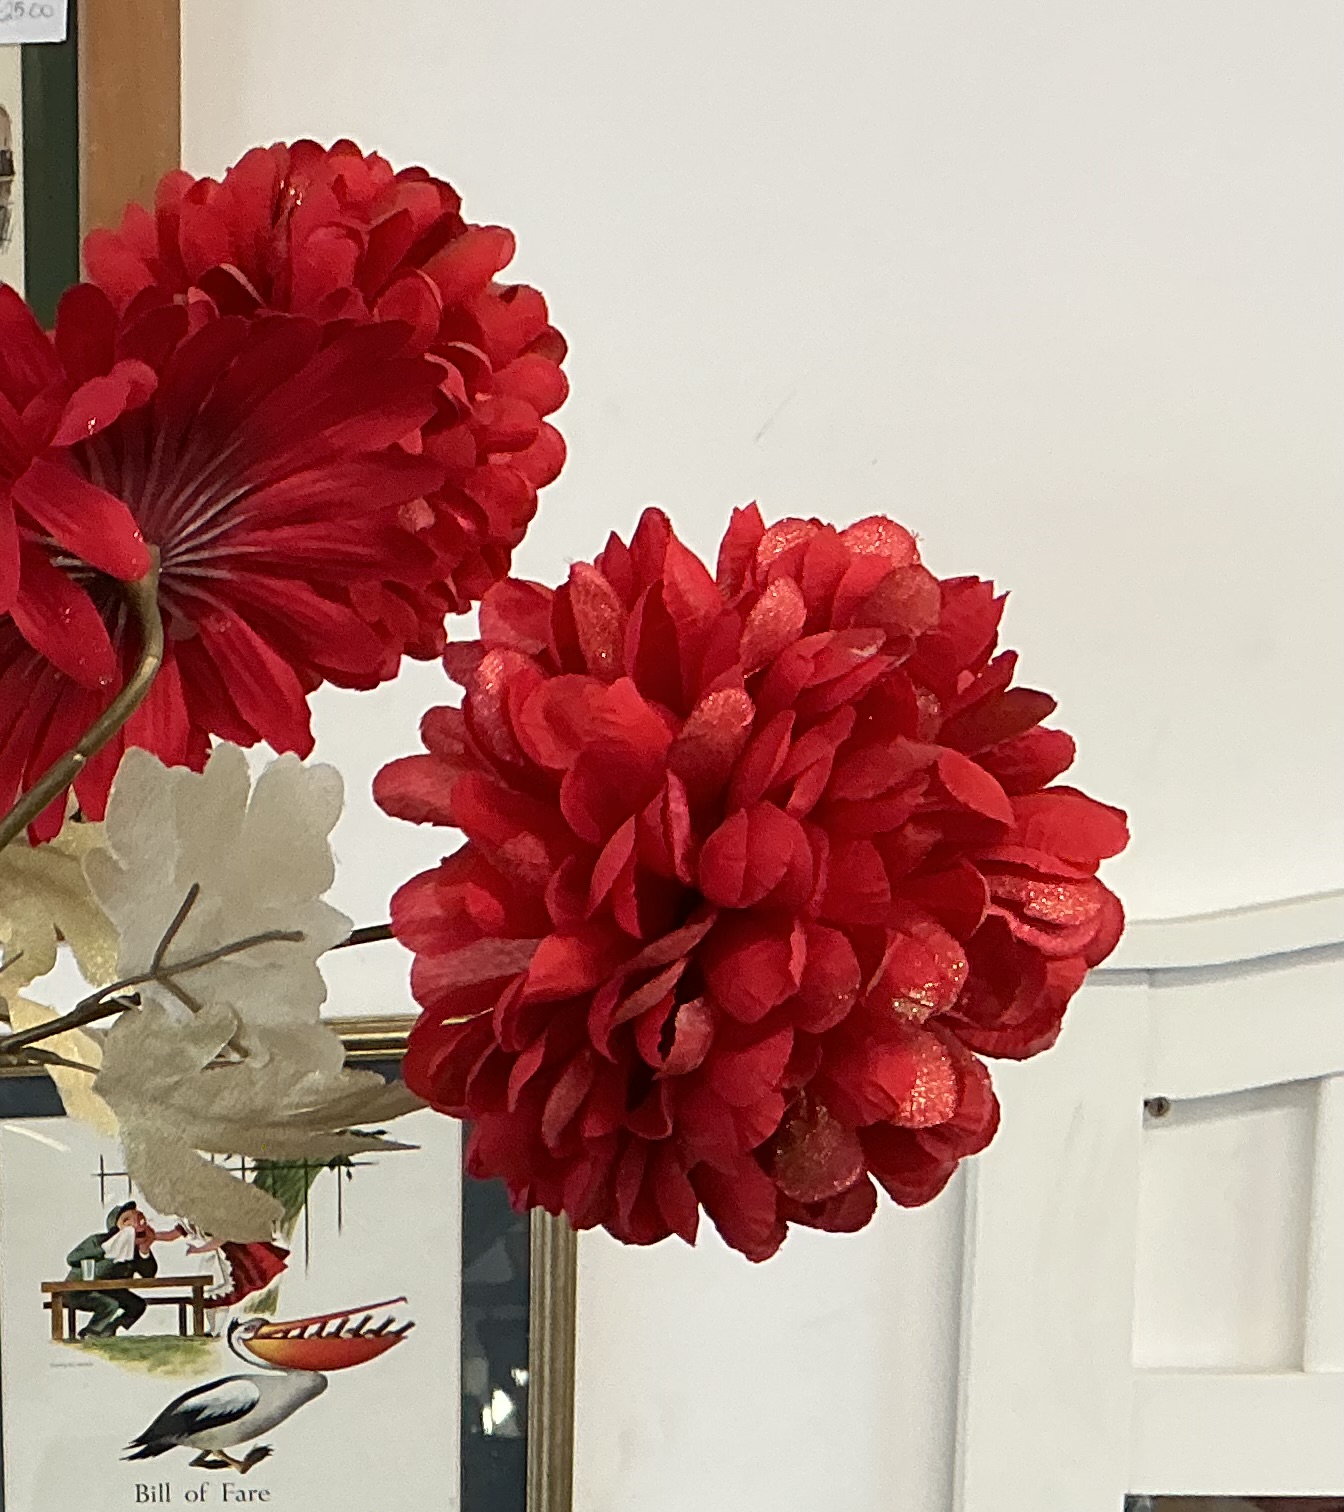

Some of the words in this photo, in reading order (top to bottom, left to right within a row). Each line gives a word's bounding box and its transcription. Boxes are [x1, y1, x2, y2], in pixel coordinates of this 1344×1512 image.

[134, 1482, 171, 1503] Bill
[185, 1482, 209, 1502] of
[221, 1483, 272, 1503] Fare
